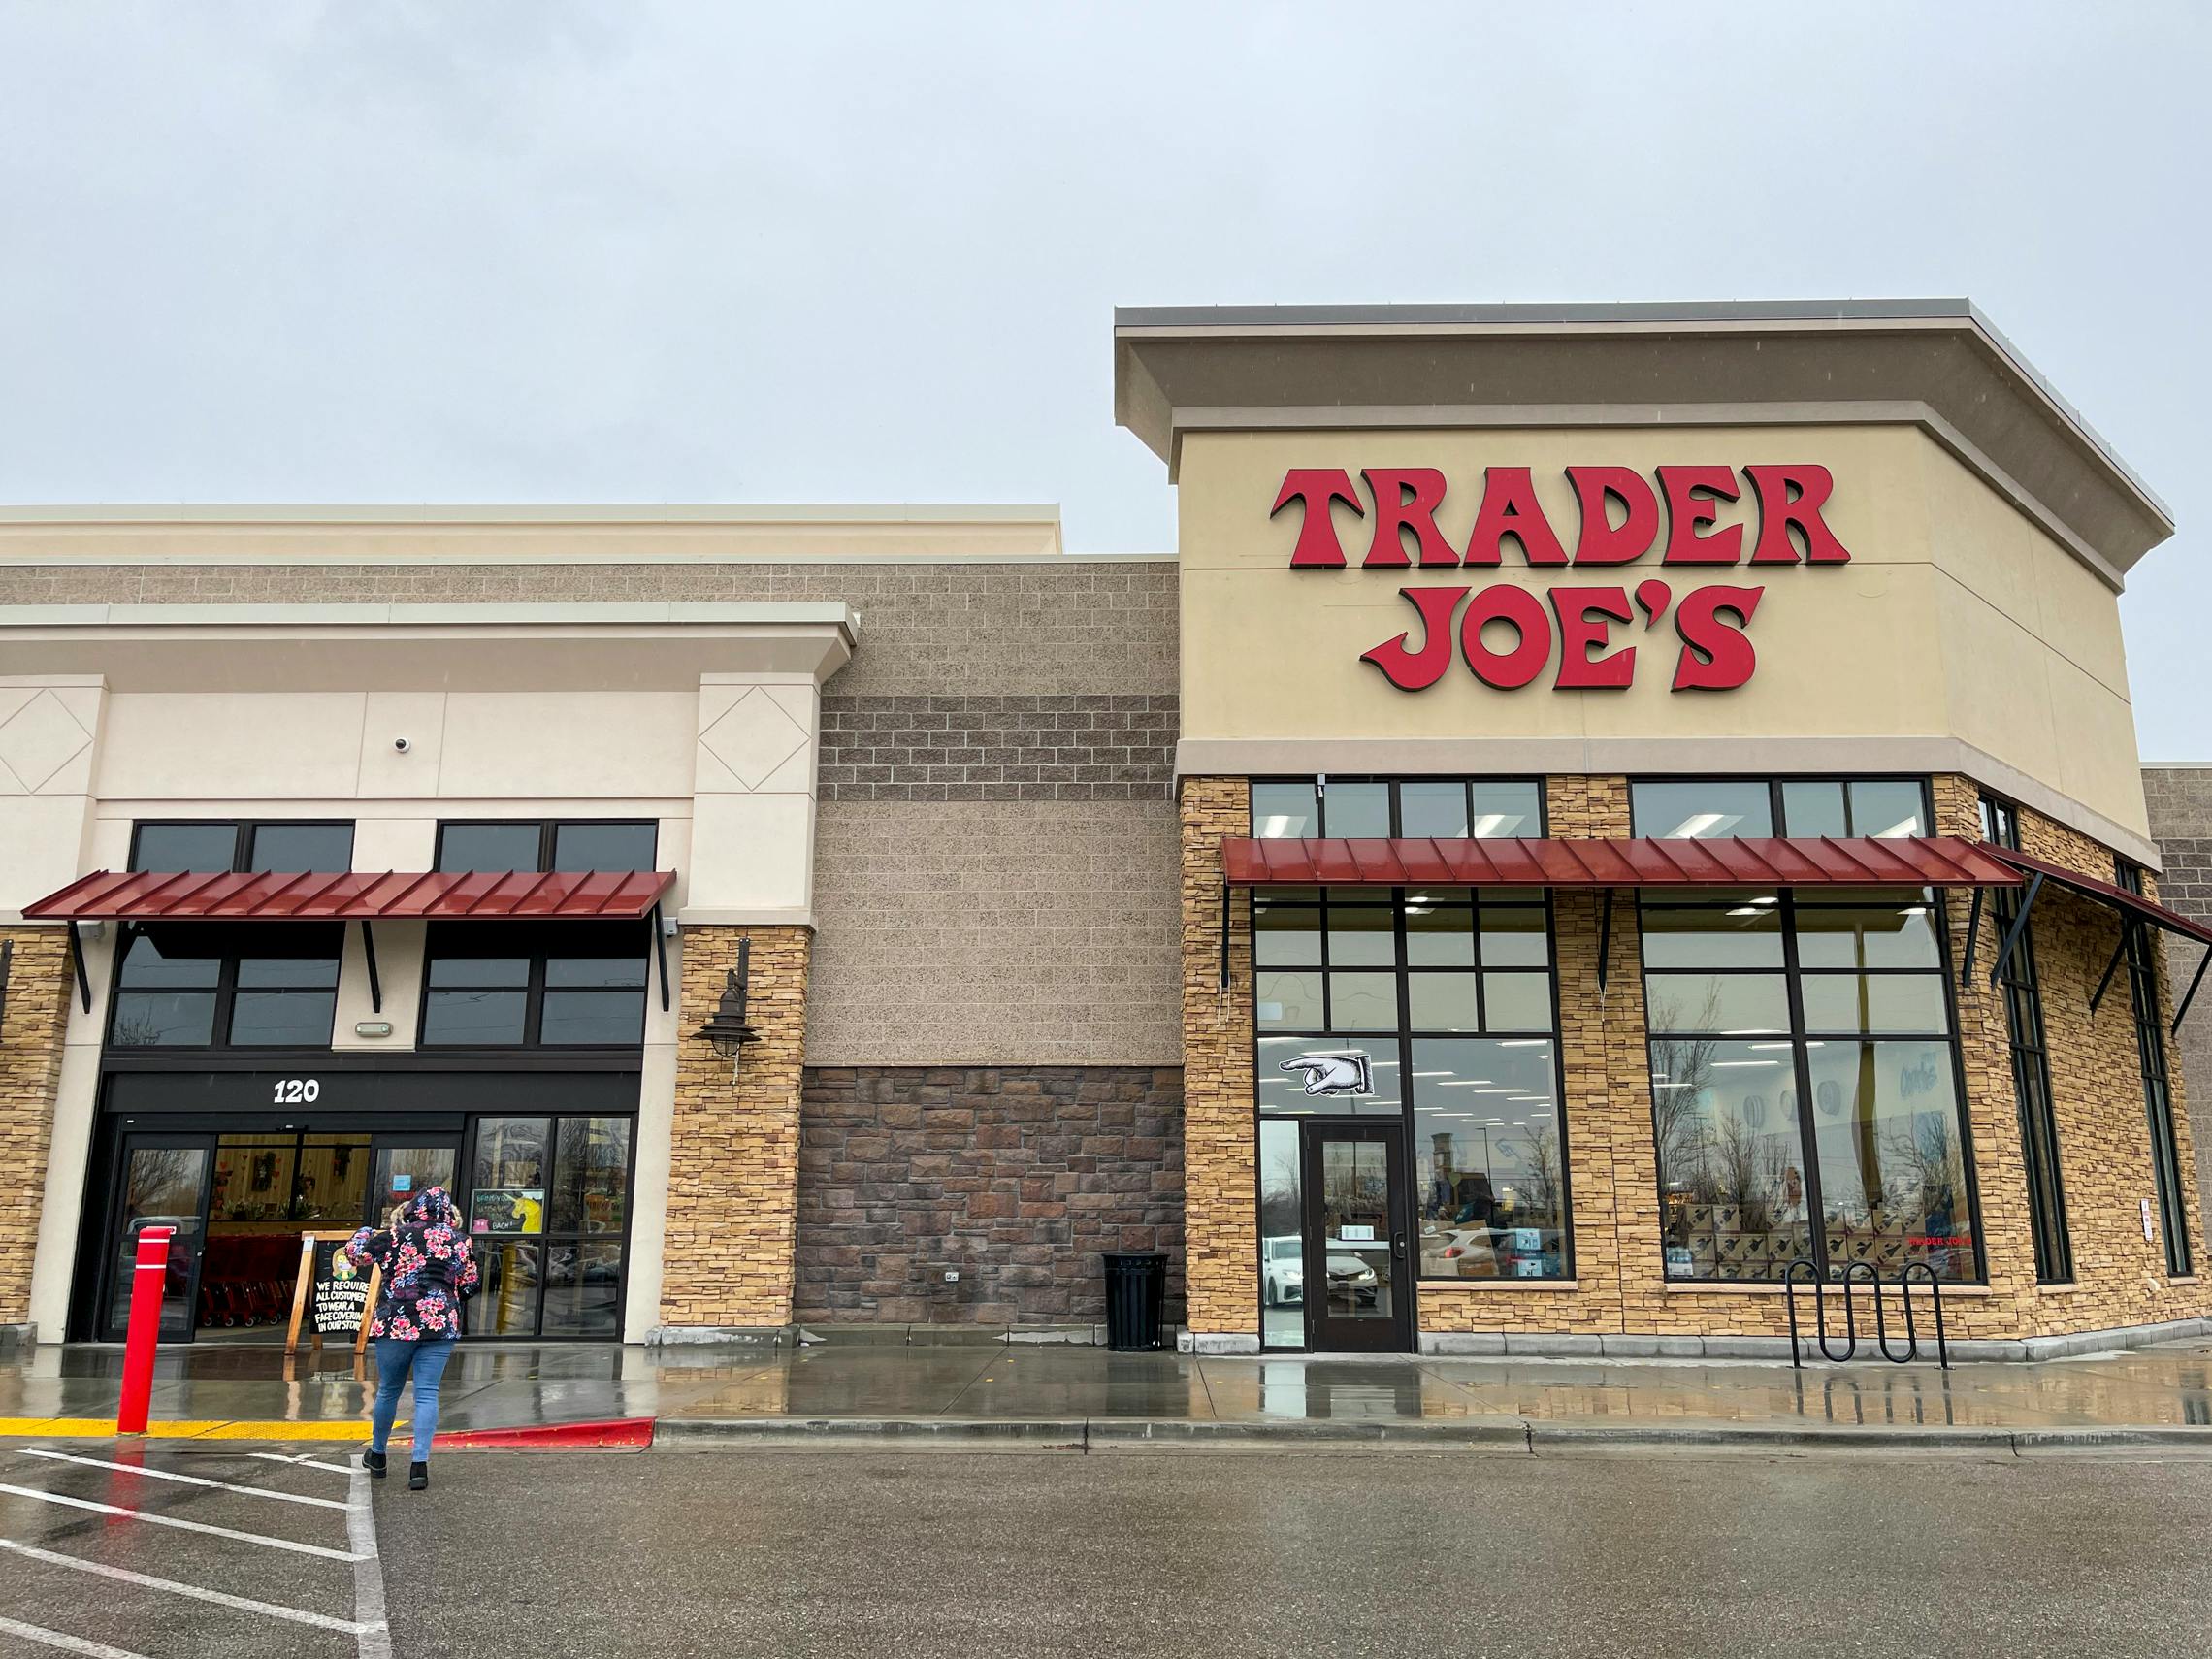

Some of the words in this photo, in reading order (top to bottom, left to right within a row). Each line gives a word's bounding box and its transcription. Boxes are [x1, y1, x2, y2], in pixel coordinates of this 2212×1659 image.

[1270, 465, 1851, 569] TRADER
[1359, 579, 1765, 693] JOE'S
[274, 1079, 320, 1103] 120
[316, 1281, 330, 1291] WE
[333, 1281, 370, 1292] REQUIRE
[315, 1291, 331, 1302] ALL
[330, 1291, 366, 1303] CUSTOMER
[316, 1301, 328, 1313] TO
[328, 1301, 348, 1311] WEAR
[347, 1301, 355, 1311] A
[314, 1312, 333, 1323] FACE
[332, 1311, 364, 1320] COVERIN
[318, 1322, 327, 1332] IN
[327, 1320, 342, 1330] OUR
